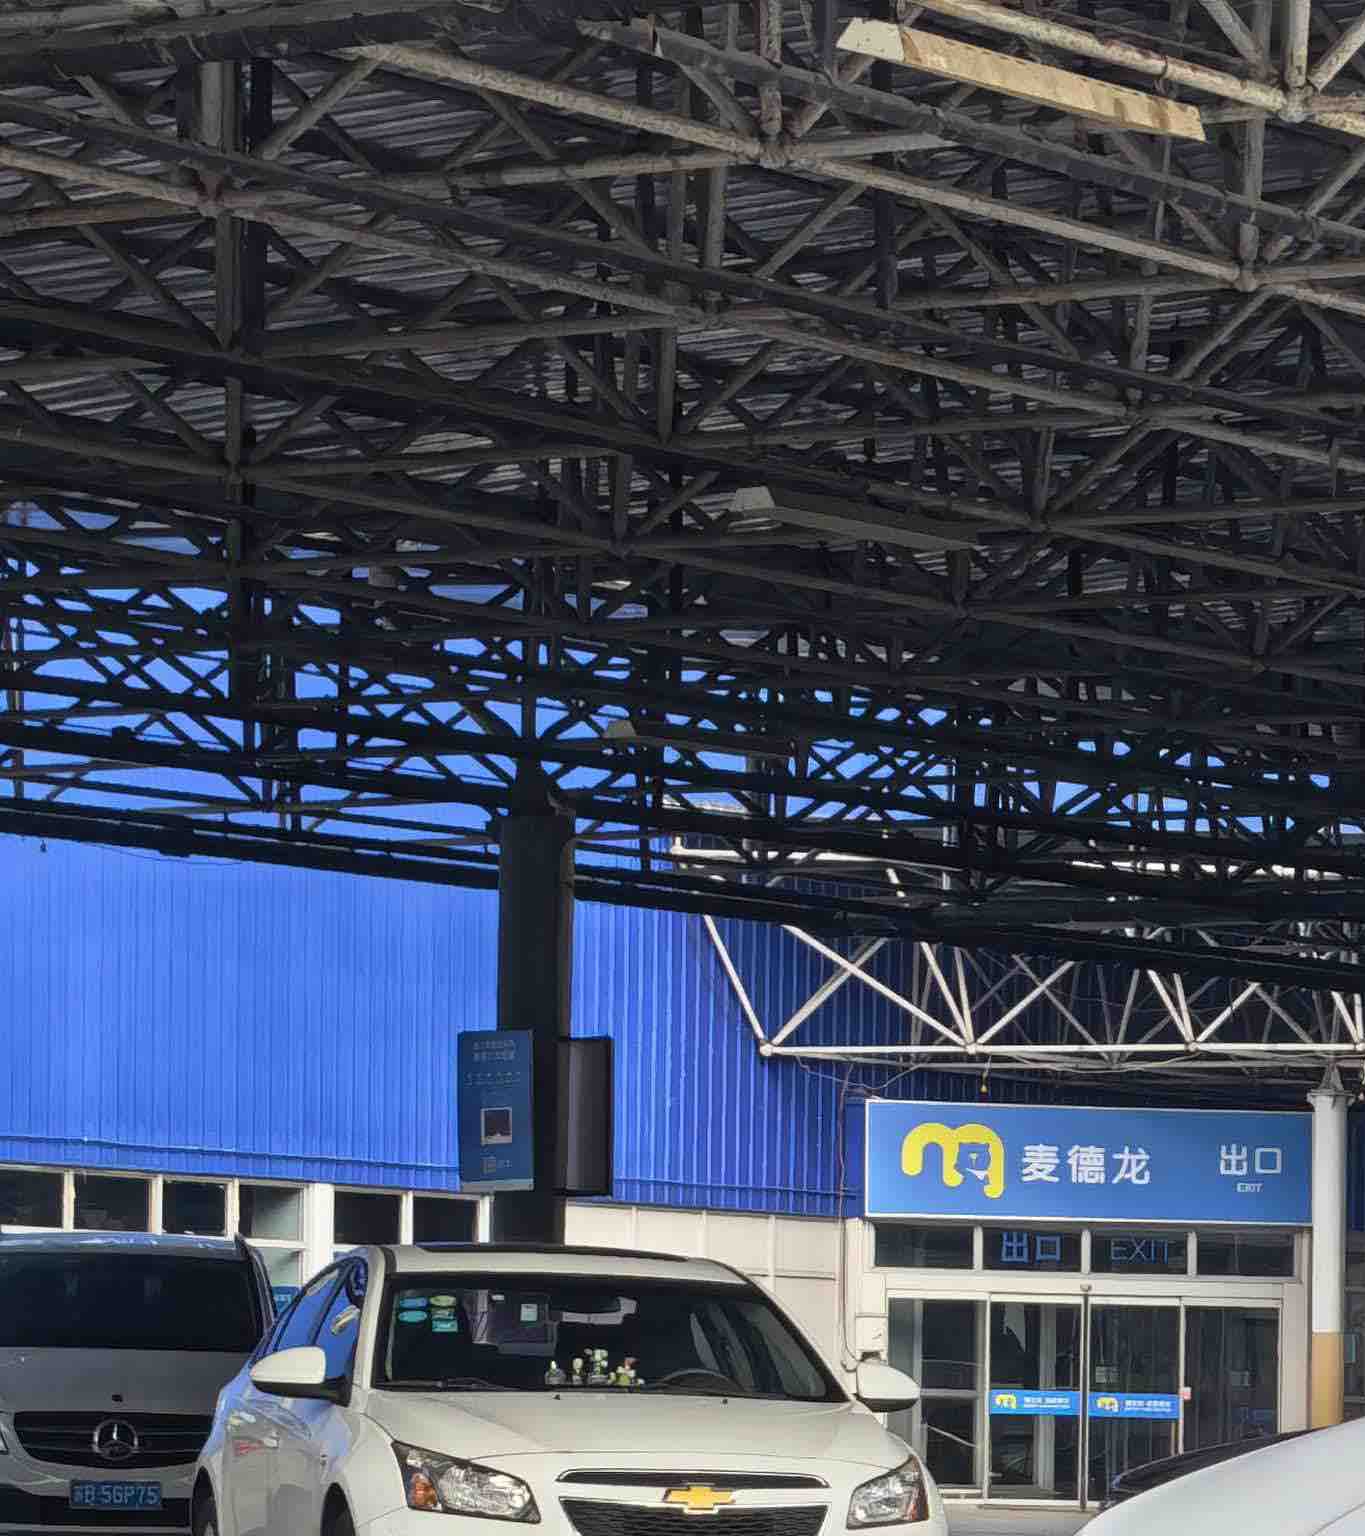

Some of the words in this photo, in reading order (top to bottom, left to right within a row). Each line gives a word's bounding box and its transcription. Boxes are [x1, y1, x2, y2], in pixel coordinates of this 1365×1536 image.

[1020, 1143, 1151, 1185] 麦德龙
[1219, 1144, 1283, 1176] 出口
[1236, 1182, 1264, 1193] EXIT
[1000, 1231, 1063, 1264] 出口
[1110, 1238, 1175, 1265] EXIT
